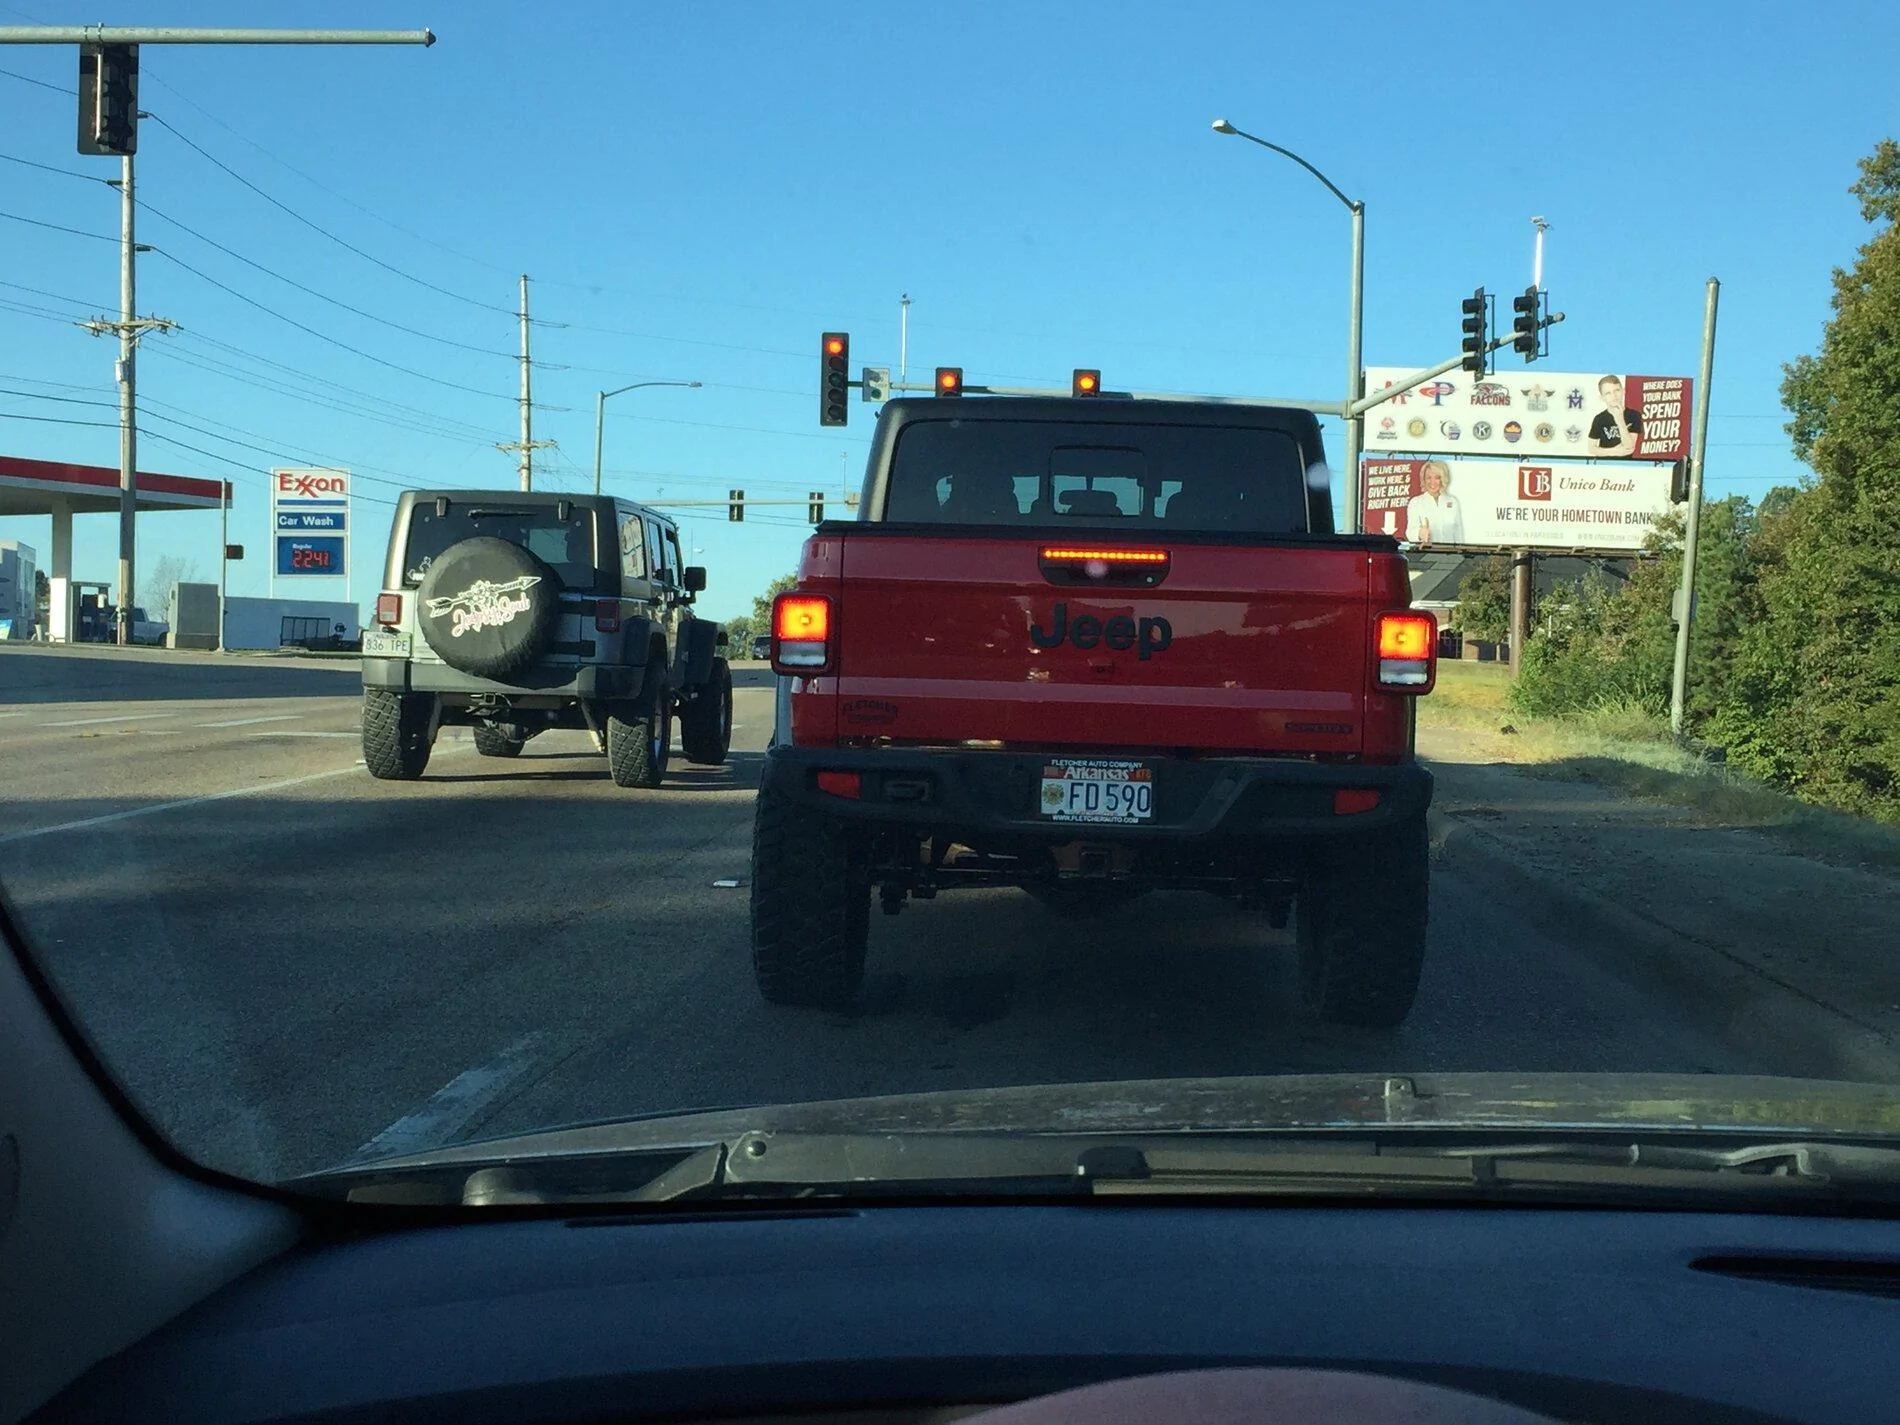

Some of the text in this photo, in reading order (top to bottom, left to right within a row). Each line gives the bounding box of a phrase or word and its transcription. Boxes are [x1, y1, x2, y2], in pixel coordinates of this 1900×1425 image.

[1643, 379, 1683, 391] WHERE DOES
[1470, 394, 1511, 406] FALCONS
[1643, 391, 1682, 403] YOUR BANK
[1641, 402, 1681, 419] SPEND
[1642, 420, 1681, 440] YOUR
[1640, 440, 1681, 454] MONEY?
[1368, 466, 1379, 475] WE
[1379, 465, 1393, 475] LIVE
[280, 473, 345, 498] Exxon
[1368, 477, 1386, 486] WORK
[1559, 477, 1635, 492] Unico Bank
[1368, 484, 1411, 498] GIVE BACK
[1367, 498, 1390, 510] RIGHT
[279, 516, 334, 526] Car Wash
[1496, 507, 1529, 521] WE'RE
[1531, 509, 1559, 522] YOUR
[1561, 510, 1622, 524] HOMETOWN
[1030, 603, 1172, 661] Jeep
[1051, 759, 1143, 769] FLETCHER AUTO COMPANY
[1063, 766, 1130, 780] Arkansas
